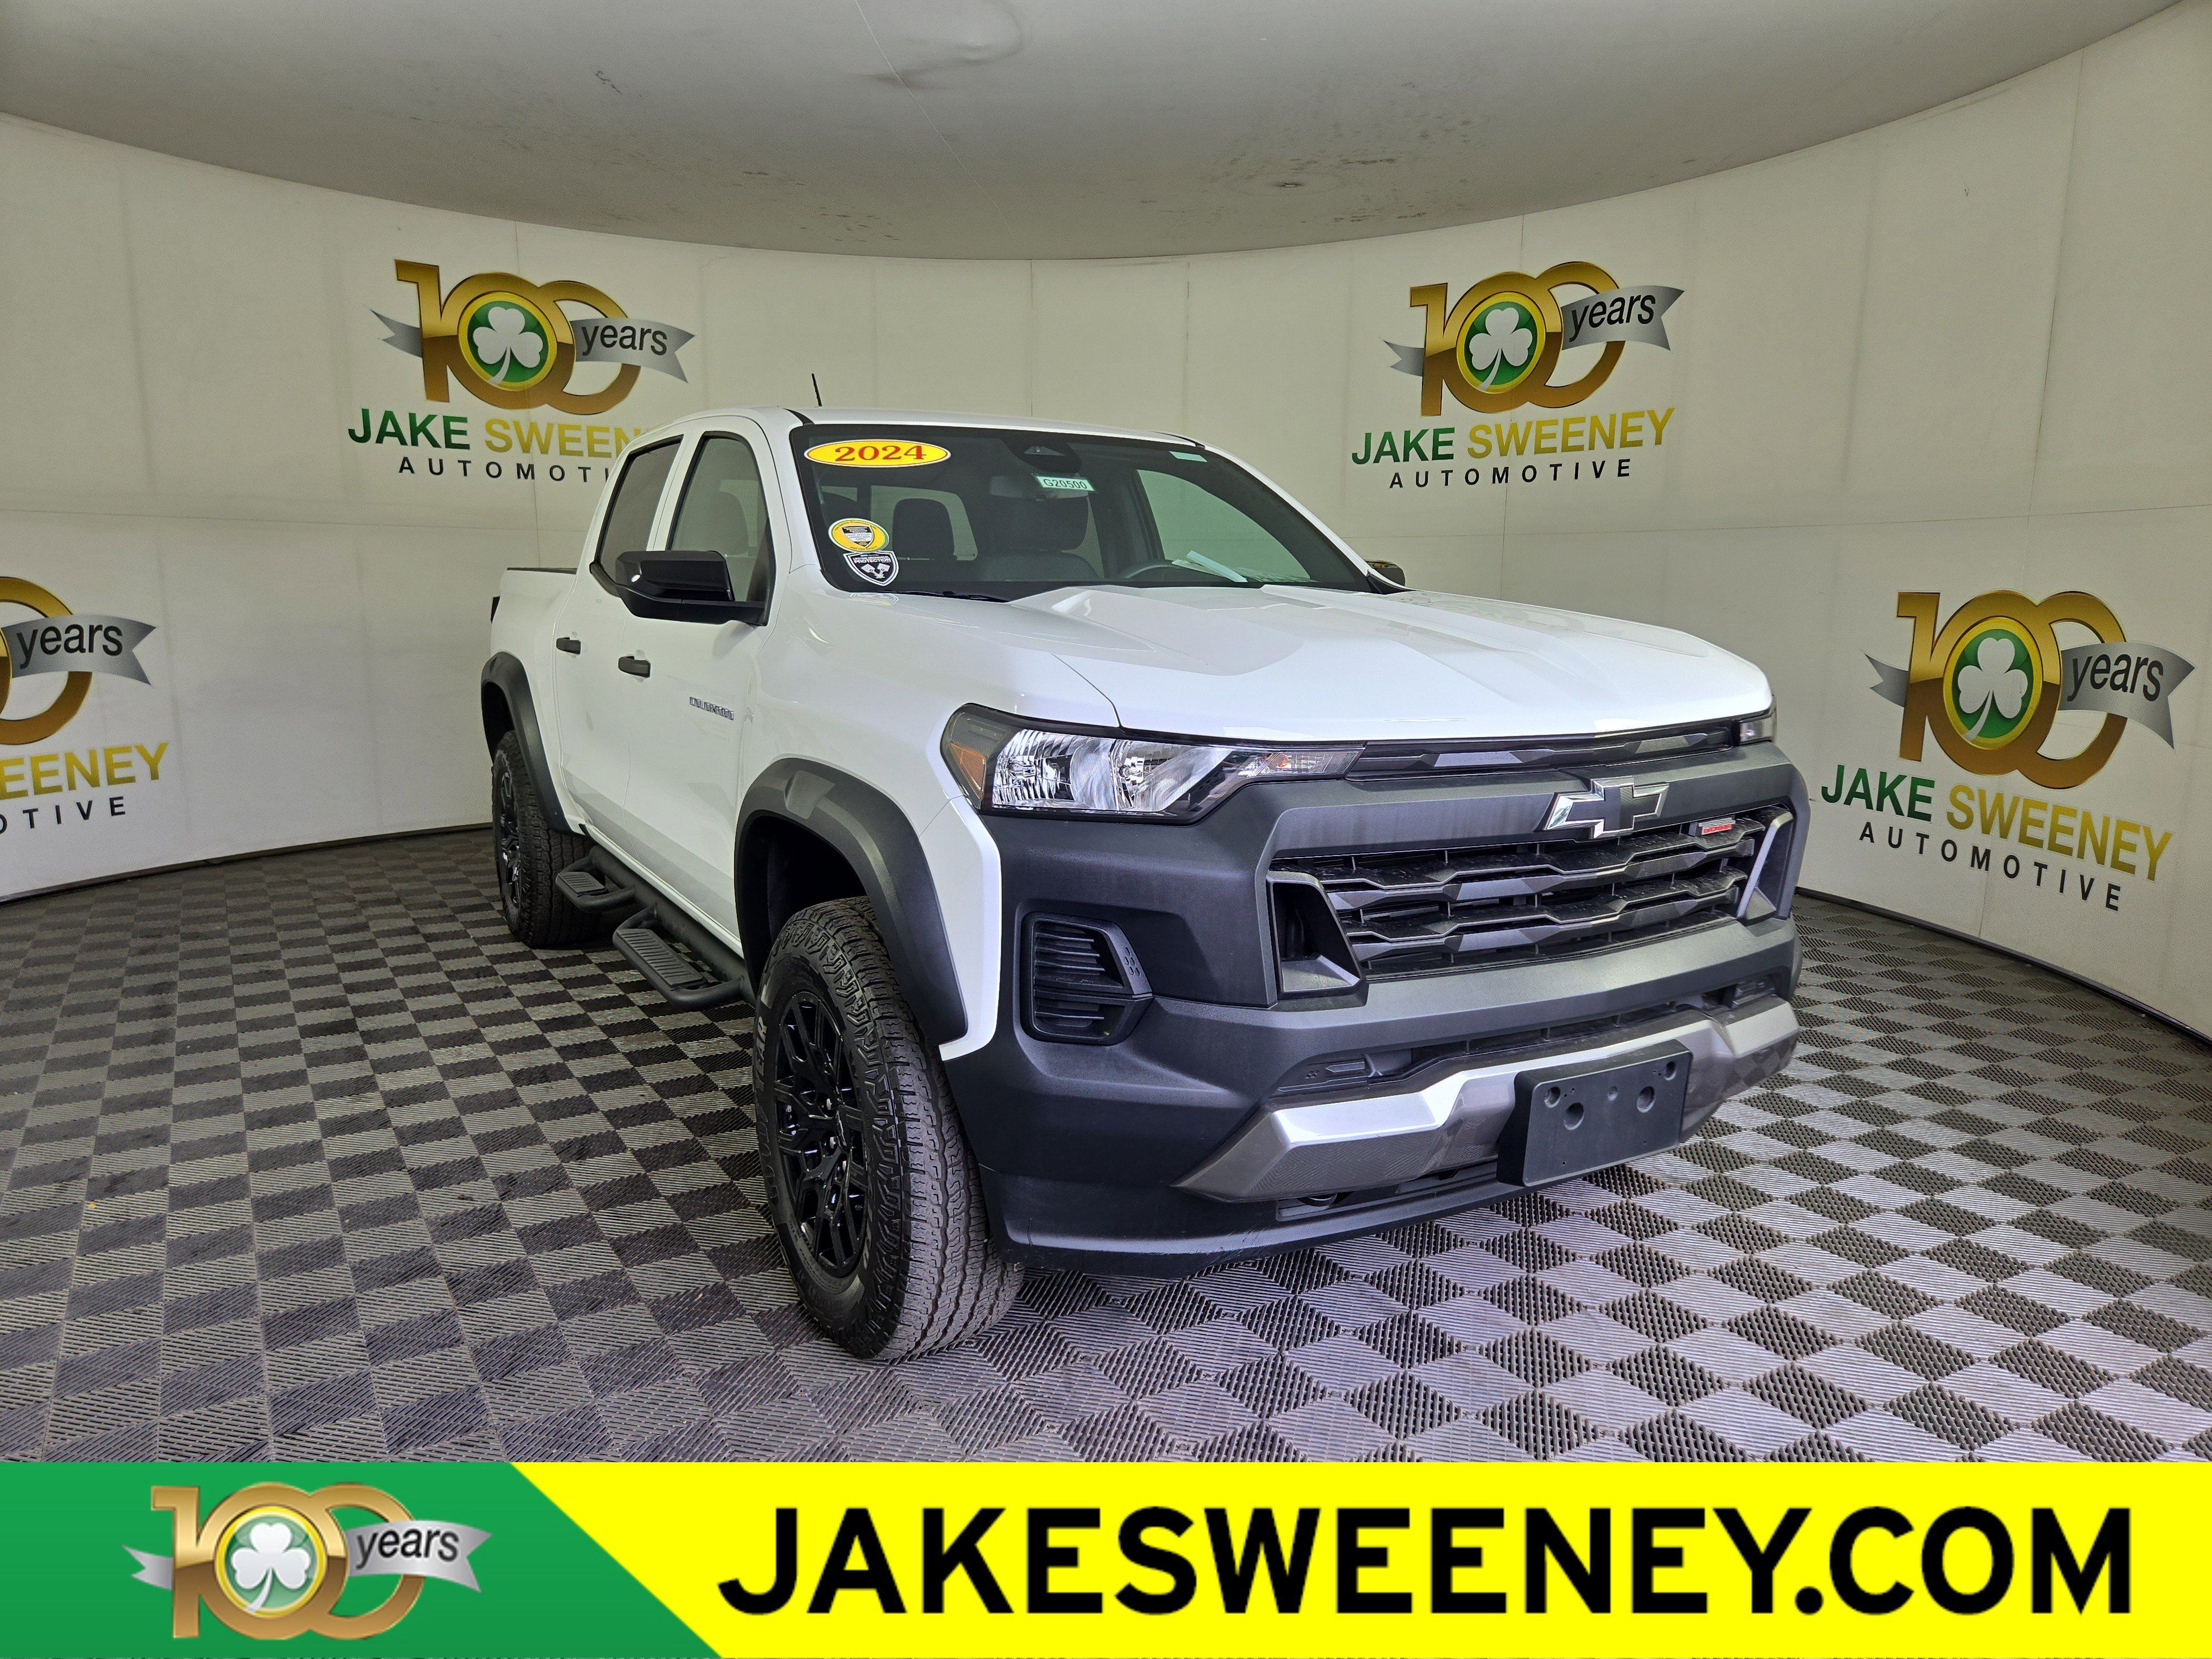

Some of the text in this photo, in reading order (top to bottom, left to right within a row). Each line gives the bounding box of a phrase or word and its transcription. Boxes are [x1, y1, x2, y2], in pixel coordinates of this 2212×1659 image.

[582, 324, 668, 356] years
[1569, 294, 1656, 342] years
[348, 408, 642, 458] JAKE SWEEN
[835, 445, 927, 461] 2024
[1352, 408, 1675, 465] JAKE SWEENEY
[399, 456, 609, 483] AUTOMOTI
[1043, 479, 1088, 489] G20500
[1390, 459, 1631, 488] AUTOMOTIVE
[17, 623, 123, 670] years
[2067, 653, 2164, 702] years
[0, 742, 169, 800] EENEY
[1822, 764, 2172, 882] JAKE SWEENEY
[1860, 822, 2121, 911] AUTOMOTIVE
